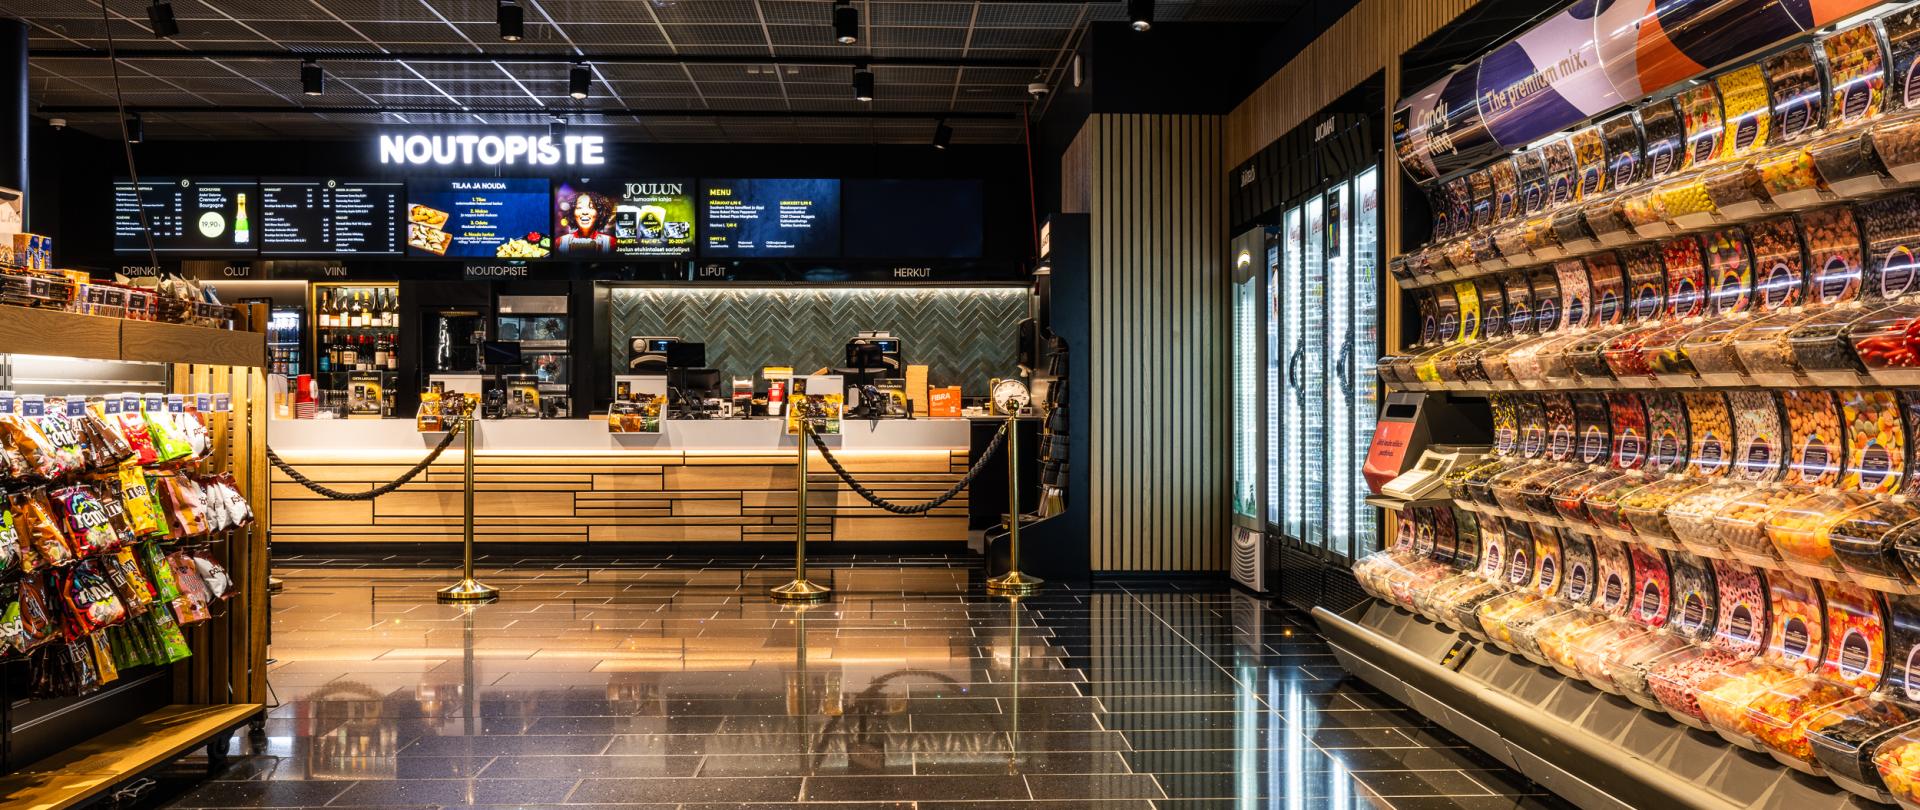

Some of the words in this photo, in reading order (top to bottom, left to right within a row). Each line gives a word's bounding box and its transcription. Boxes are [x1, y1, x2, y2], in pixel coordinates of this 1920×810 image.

[1486, 88, 1507, 113] The
[1507, 66, 1559, 108] premium
[1558, 49, 1588, 77] mix.
[1417, 99, 1449, 129] Candy
[1314, 115, 1336, 143] JUOMAT
[379, 134, 605, 165] NOUTOPISTE
[451, 182, 472, 190] TILAA
[472, 182, 482, 190] JA
[482, 182, 507, 190] NOUDA
[623, 183, 683, 199] JOULUN
[223, 266, 250, 277] OLUT
[323, 266, 348, 277] VIINI
[466, 266, 528, 276] NOUTOPISTE
[699, 266, 726, 277] LIPUT
[893, 267, 931, 277] HERKUT
[931, 392, 951, 402] FIBRA
